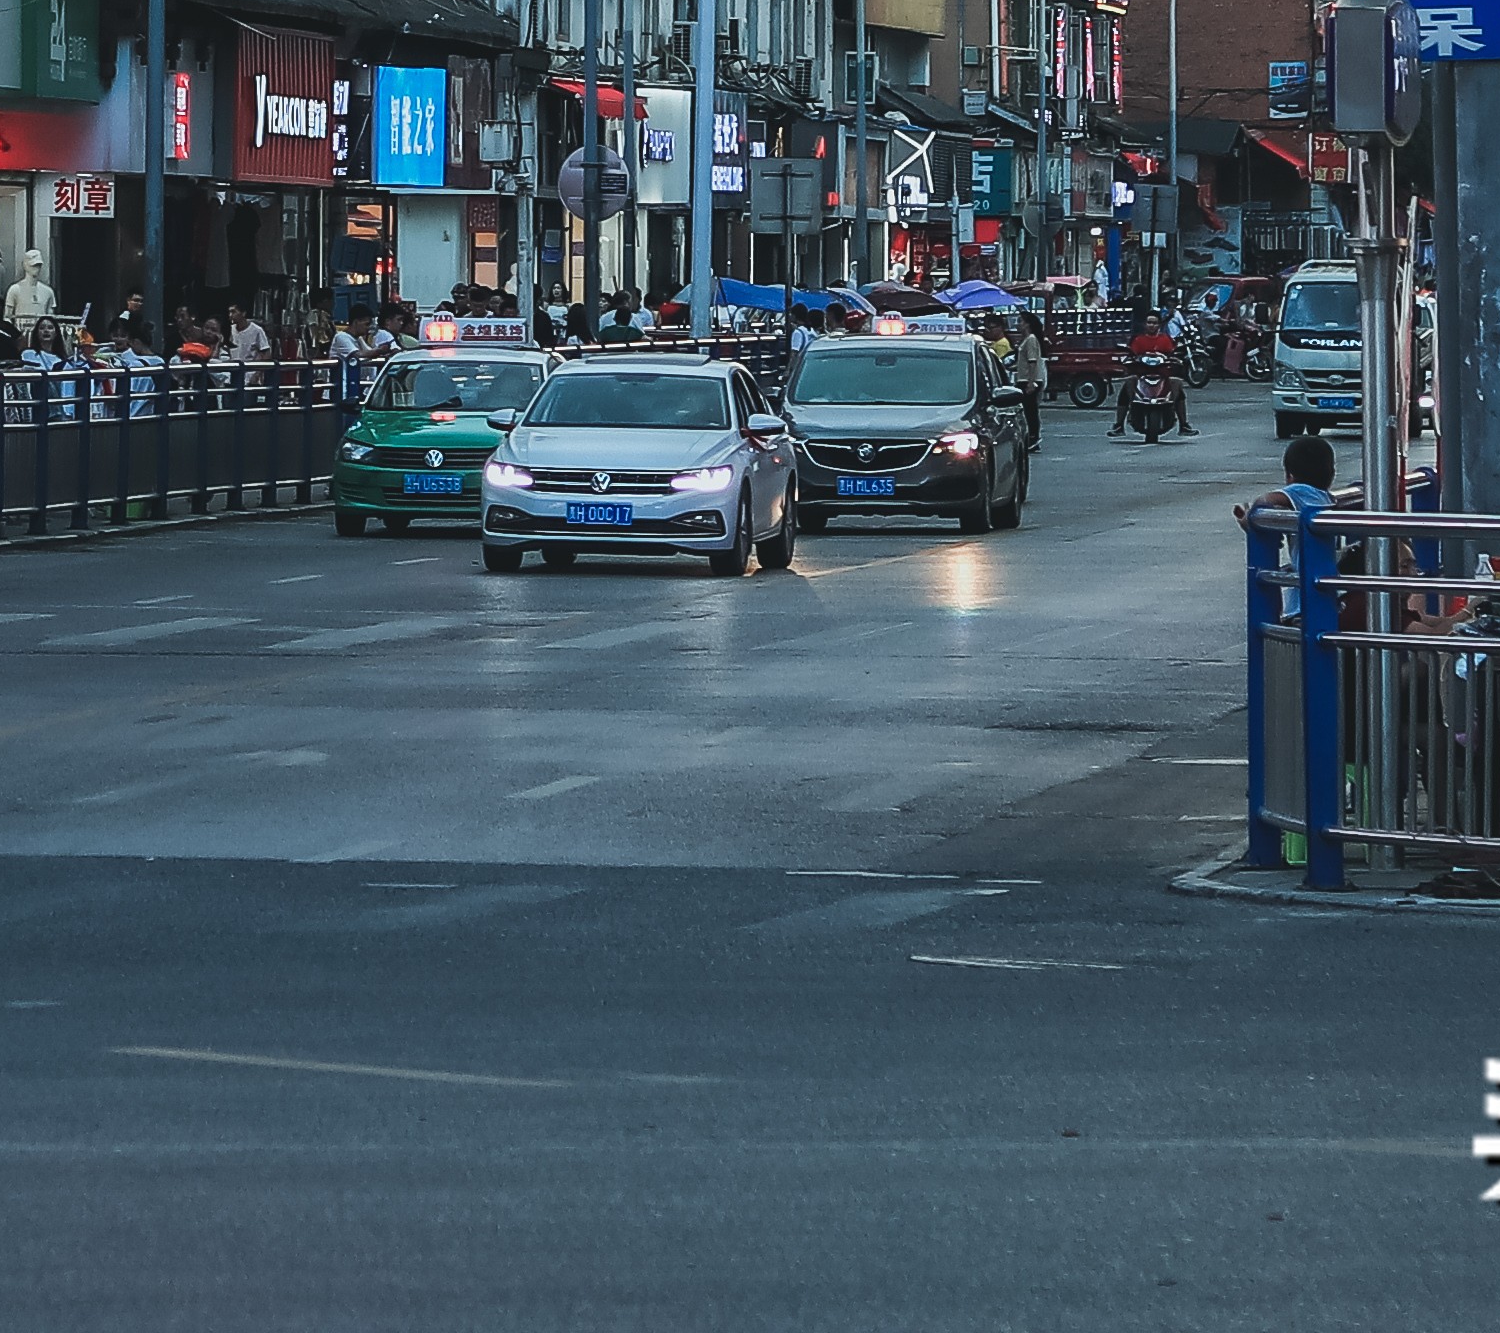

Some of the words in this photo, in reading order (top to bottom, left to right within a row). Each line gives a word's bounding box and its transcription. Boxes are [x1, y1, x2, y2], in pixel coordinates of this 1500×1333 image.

[266, 95, 307, 136] YEARCON
[53, 177, 115, 214] 刻章
[1300, 338, 1363, 347] FORLAN
